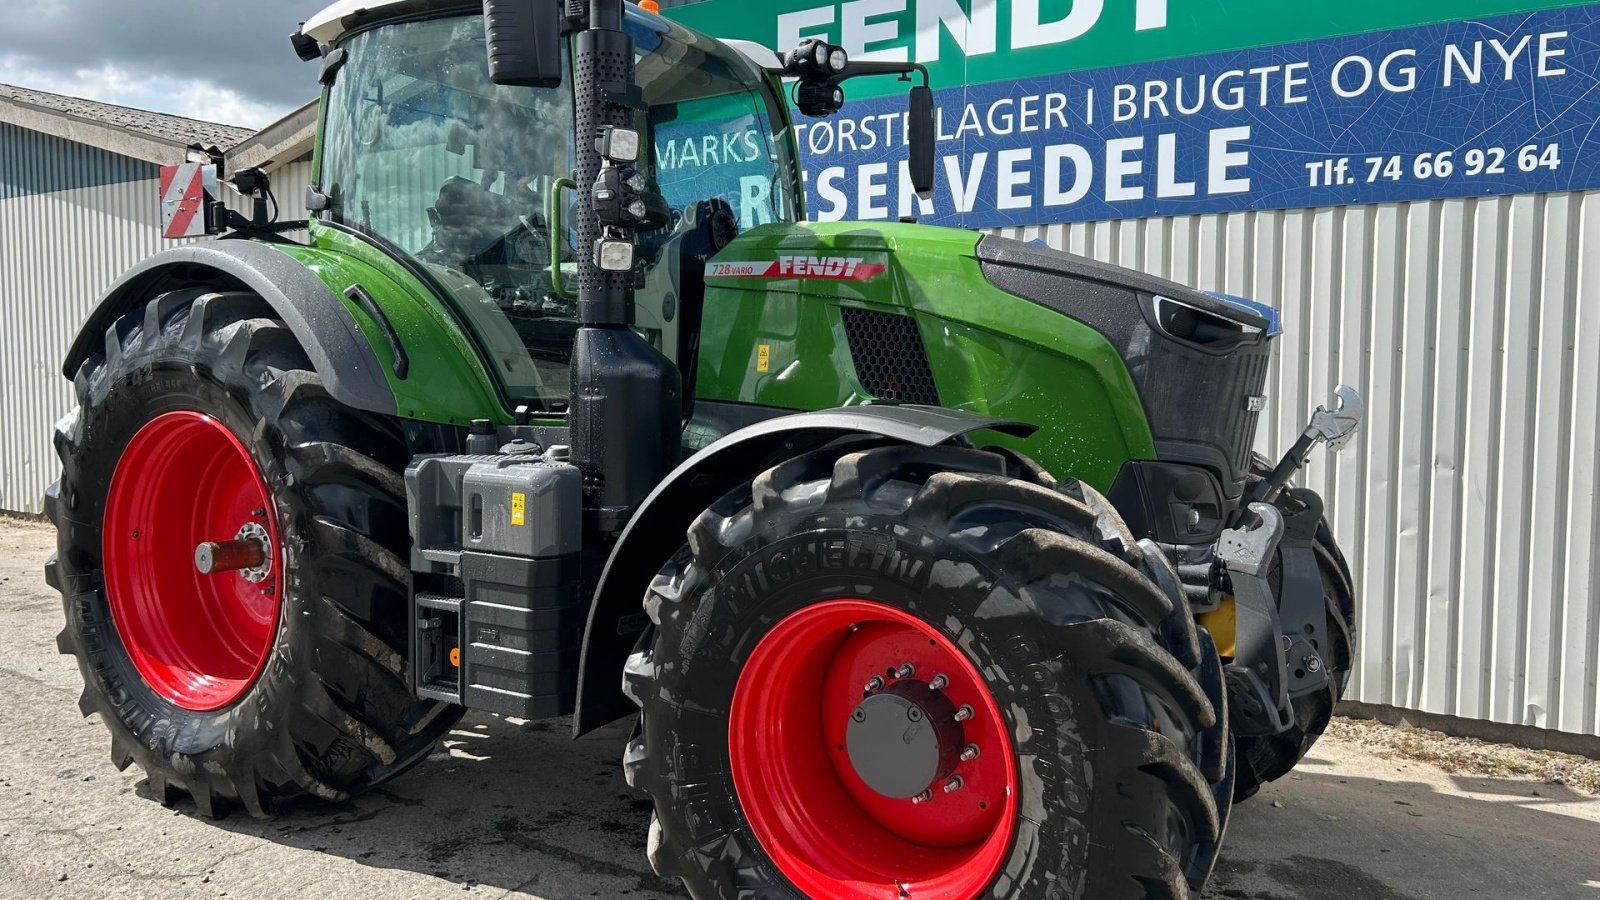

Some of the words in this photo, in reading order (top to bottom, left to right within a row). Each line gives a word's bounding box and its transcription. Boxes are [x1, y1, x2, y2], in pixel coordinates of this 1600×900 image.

[937, 93, 1068, 142] LAGER
[1086, 88, 1093, 124] I
[1113, 62, 1308, 122] BRUGTE
[1331, 49, 1416, 98] OG
[1443, 31, 1568, 88] NYE
[1305, 159, 1354, 187] Tlf.
[1366, 156, 1402, 183] 74
[1413, 151, 1453, 180] 66
[1464, 147, 1504, 176] 92
[1517, 143, 1560, 172] 64
[713, 264, 730, 275] 728
[732, 267, 754, 275] VARIO
[779, 255, 864, 277] FENDT
